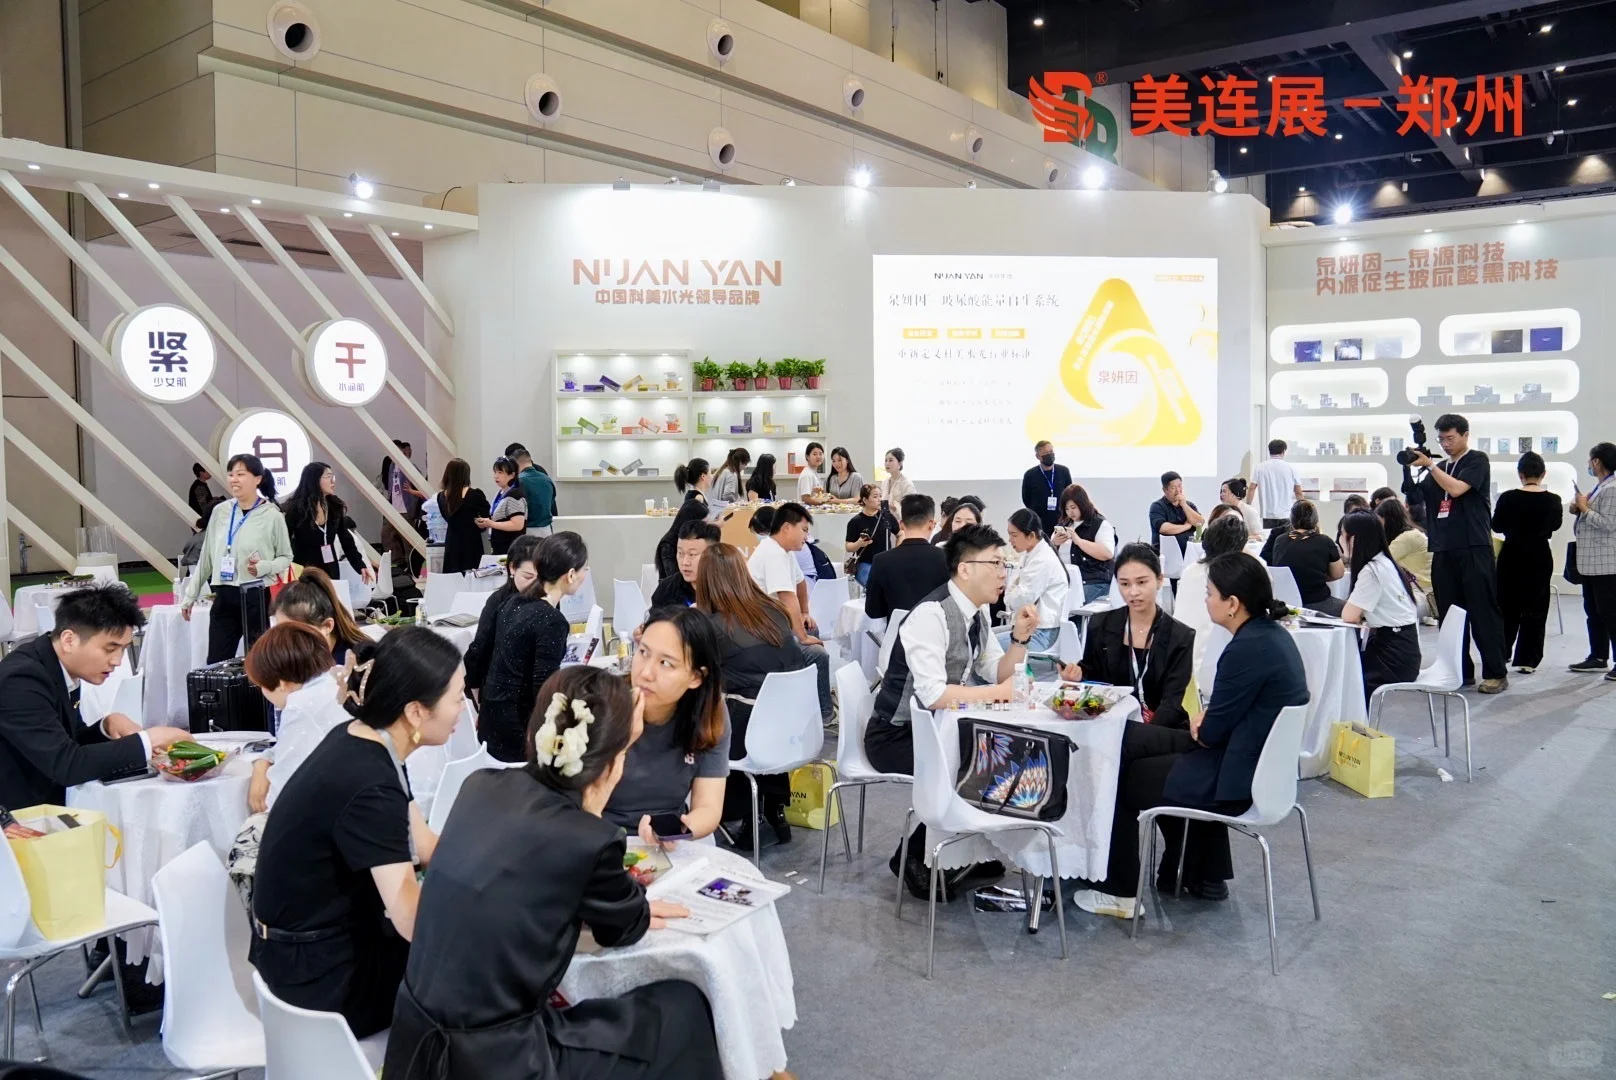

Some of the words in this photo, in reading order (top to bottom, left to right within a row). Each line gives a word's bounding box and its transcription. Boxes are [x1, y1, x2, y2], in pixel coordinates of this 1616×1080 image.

[701, 260, 782, 286] YAN
[964, 272, 984, 280] YAN
[1316, 259, 1559, 297] 内源促生玻尿酸黑科技
[595, 289, 761, 305] 中国科美水光领导品牌
[149, 331, 188, 373] 紧
[153, 376, 187, 388] 少女肌
[1097, 369, 1139, 385] 泉妍因
